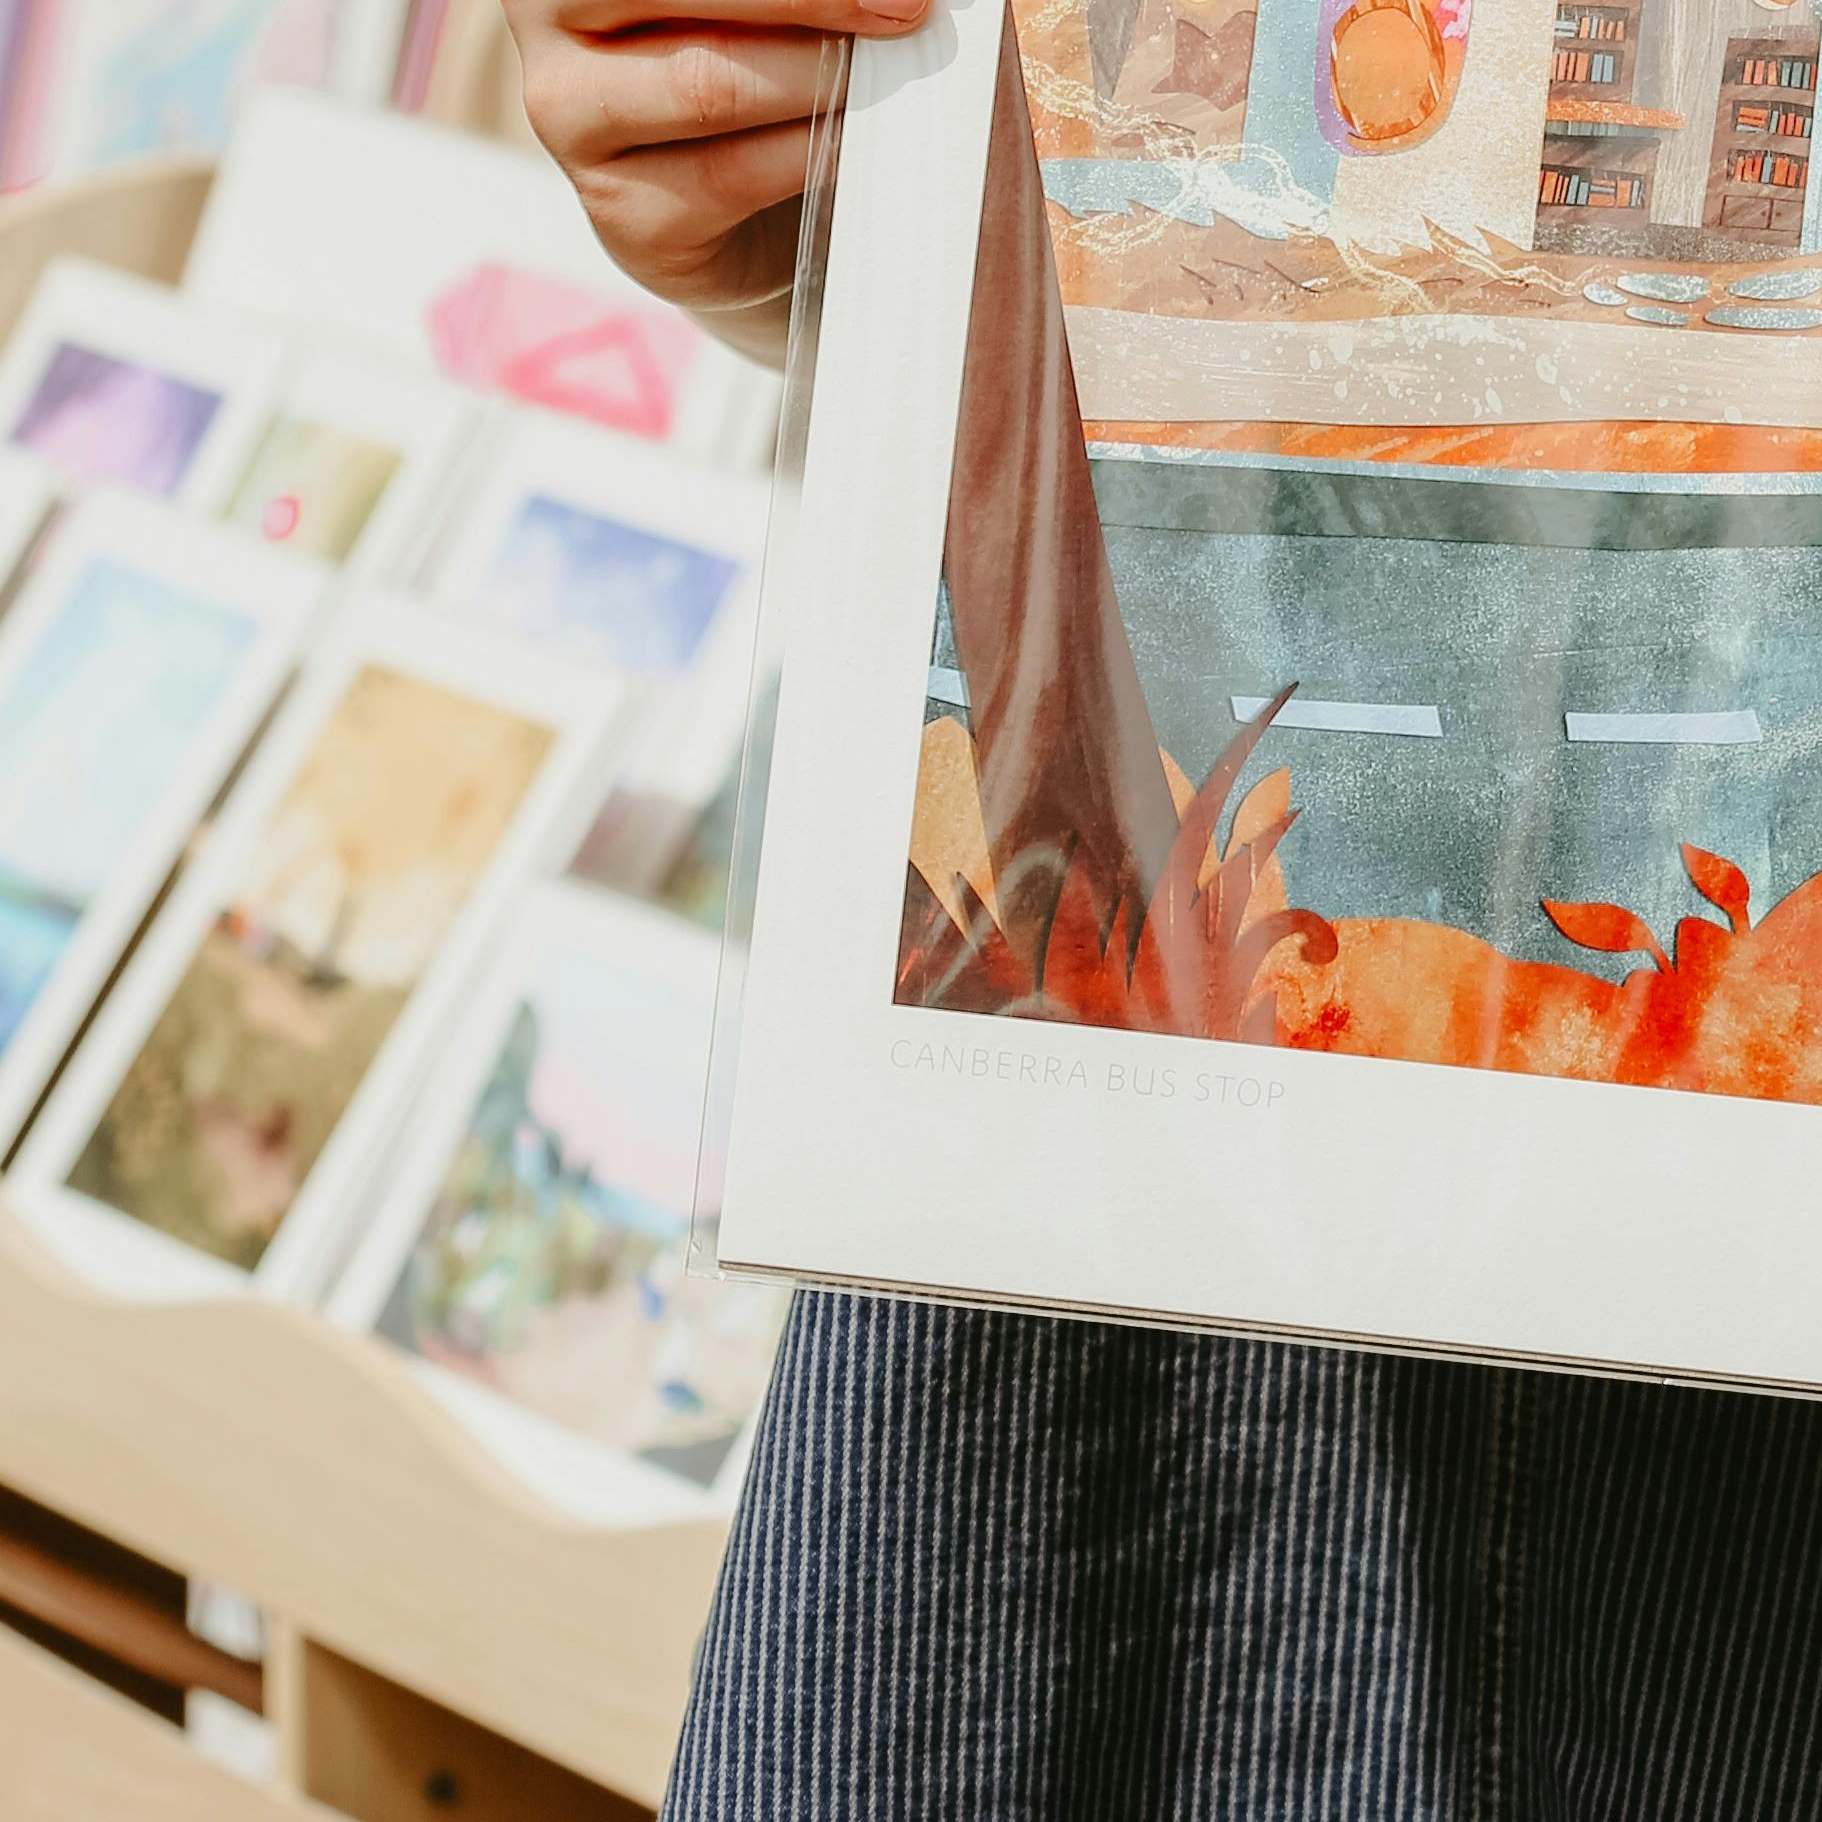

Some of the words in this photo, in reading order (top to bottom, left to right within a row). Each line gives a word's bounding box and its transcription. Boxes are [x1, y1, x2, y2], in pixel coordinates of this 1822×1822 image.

[890, 1039, 1088, 1089] CANBERRA
[1106, 1063, 1177, 1098] BUS
[1194, 1072, 1286, 1109] STOP
